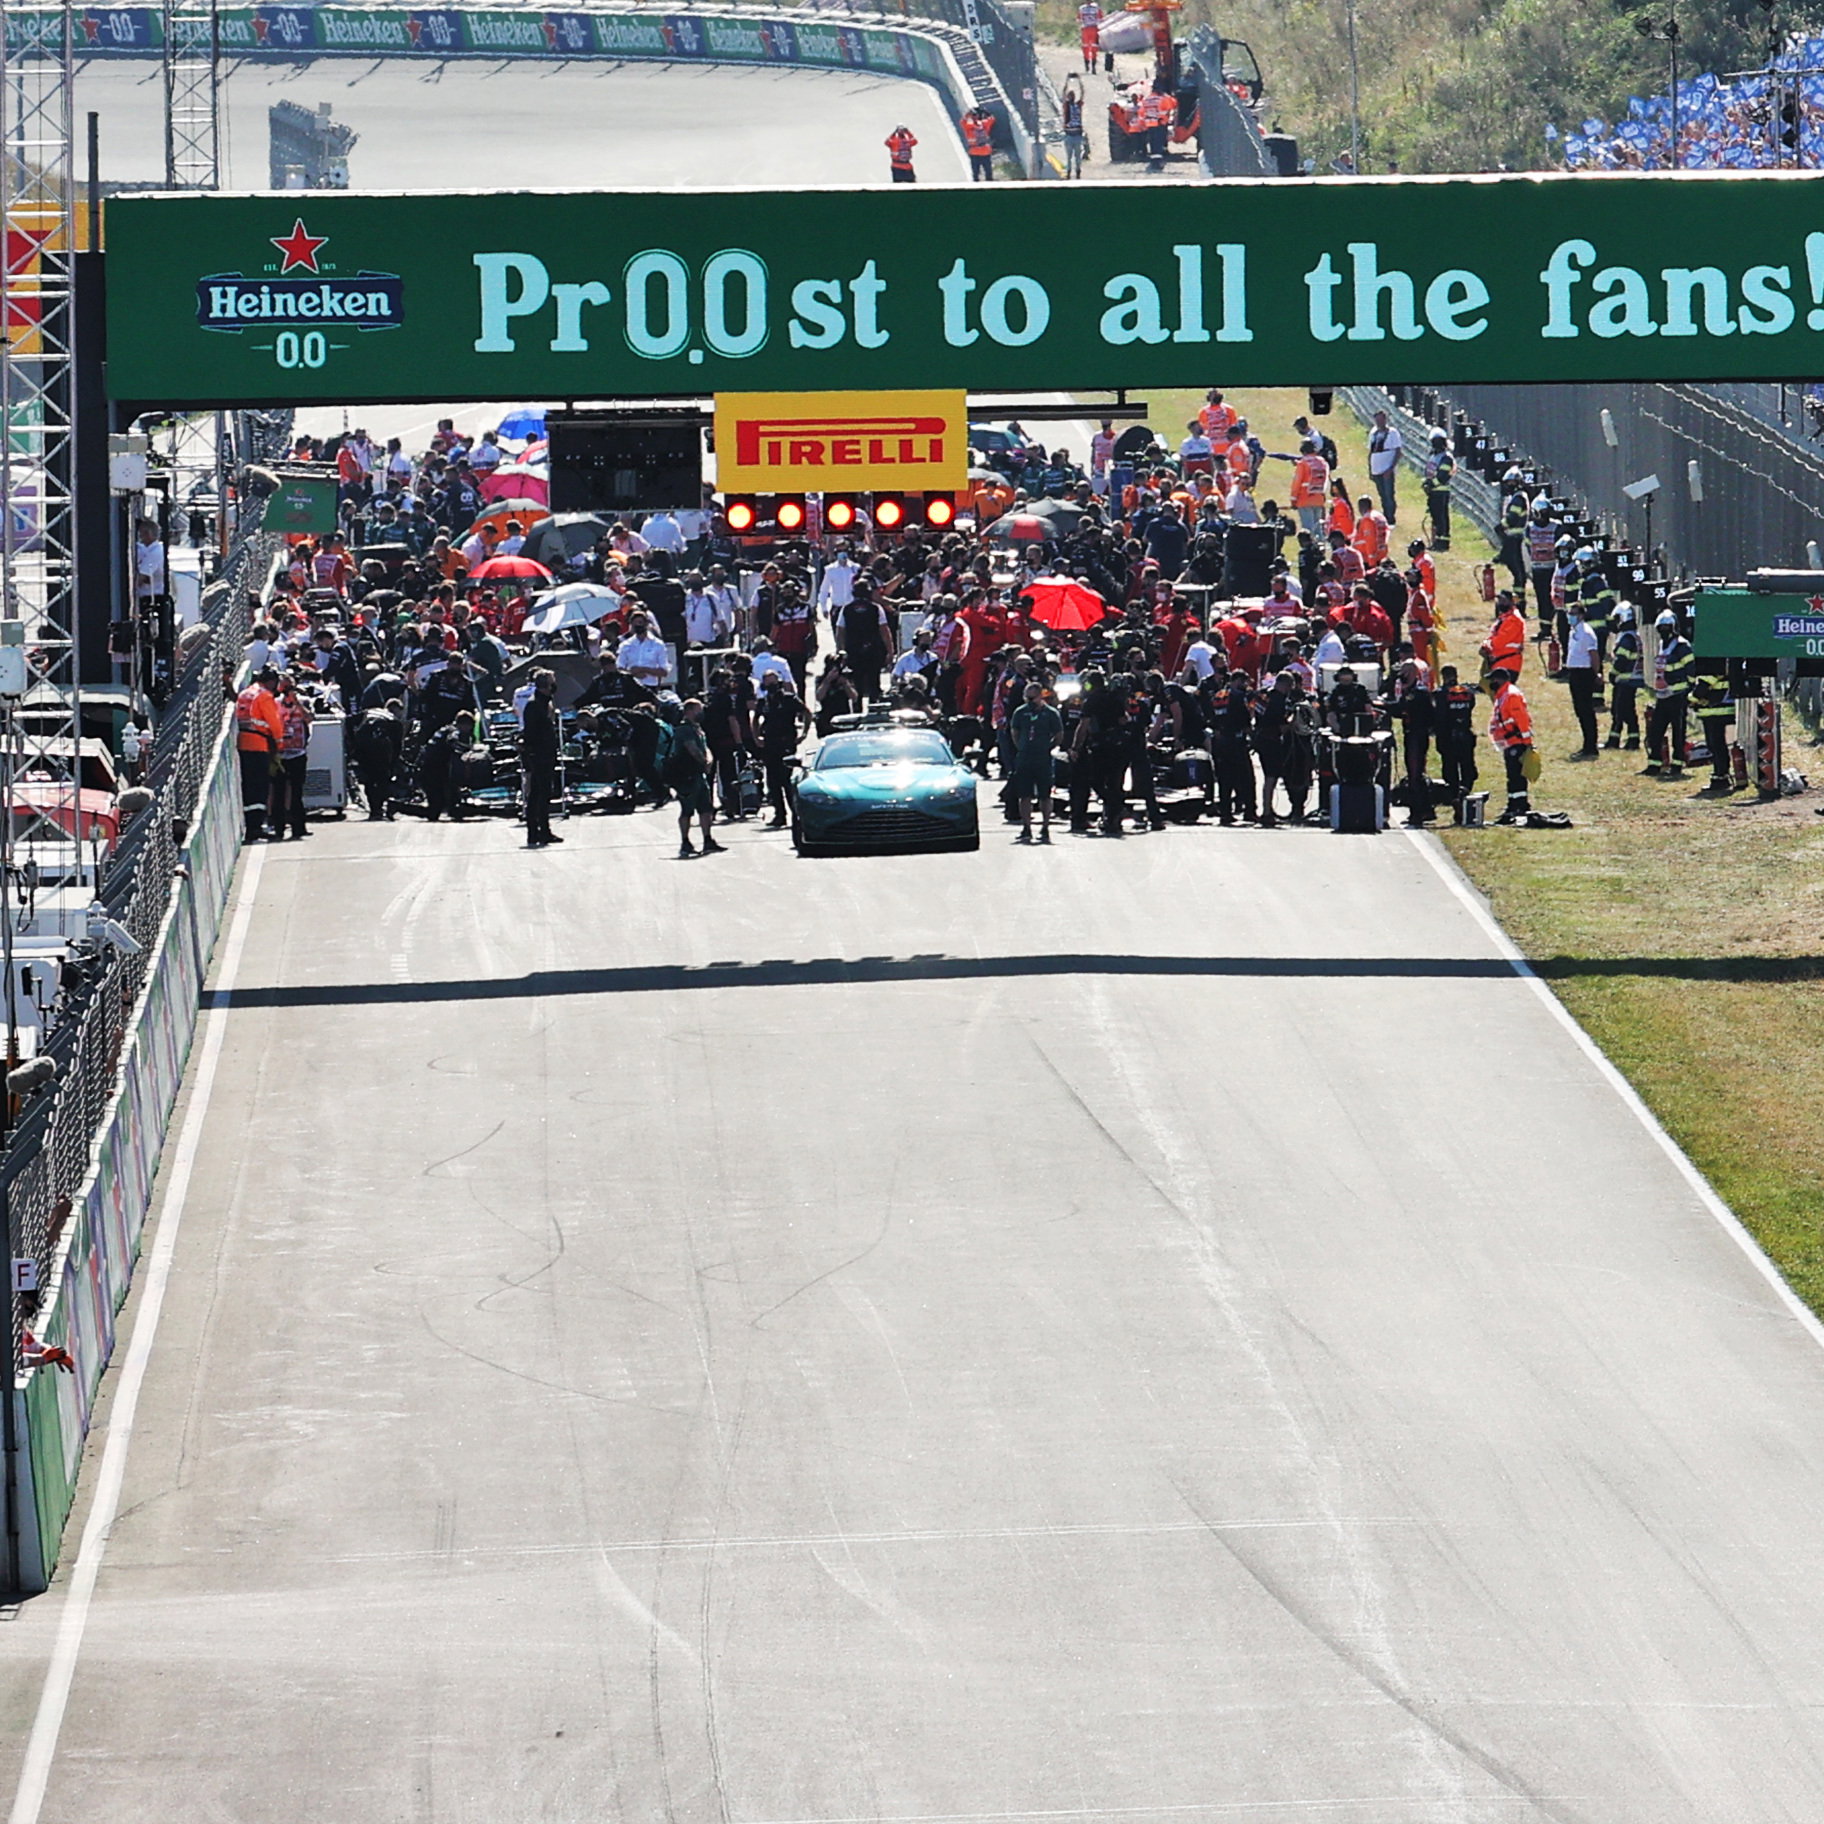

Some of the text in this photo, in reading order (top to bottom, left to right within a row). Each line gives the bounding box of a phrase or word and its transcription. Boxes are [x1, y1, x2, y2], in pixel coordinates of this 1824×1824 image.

[209, 285, 392, 318] Heineken
[938, 258, 1050, 349] to
[1099, 243, 1254, 345] all
[1304, 242, 1490, 342] the
[276, 331, 326, 368] 0.0
[735, 417, 945, 466] PIRELLI
[1632, 569, 1644, 582] 99
[1654, 587, 1665, 598] 55
[17, 1263, 31, 1287] F
